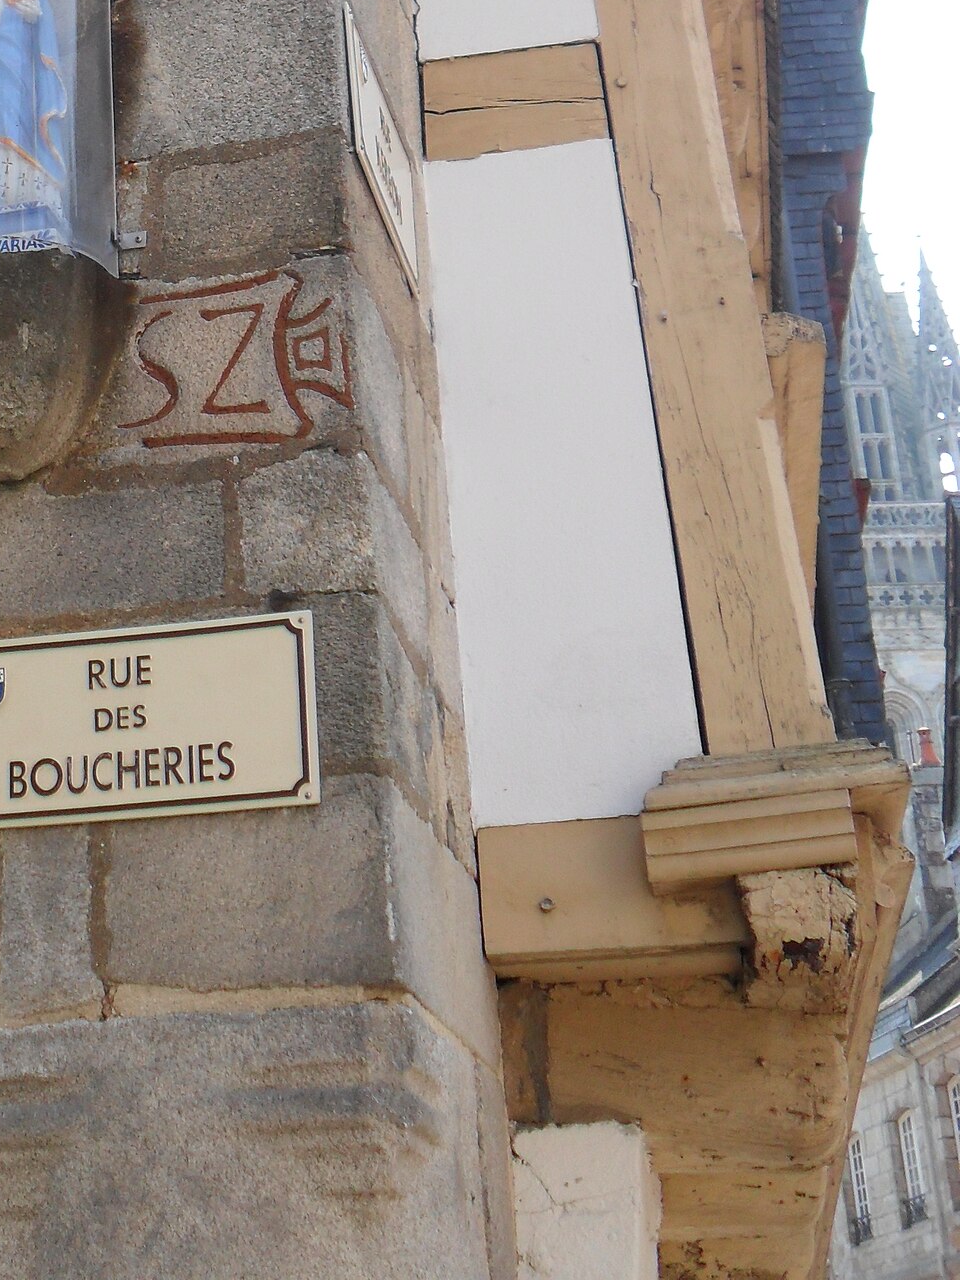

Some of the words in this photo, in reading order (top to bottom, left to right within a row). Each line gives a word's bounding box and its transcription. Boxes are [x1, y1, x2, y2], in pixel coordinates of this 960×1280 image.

[88, 654, 152, 690] RUE
[93, 704, 147, 733] DES
[9, 740, 236, 800] BOUCHERIES
